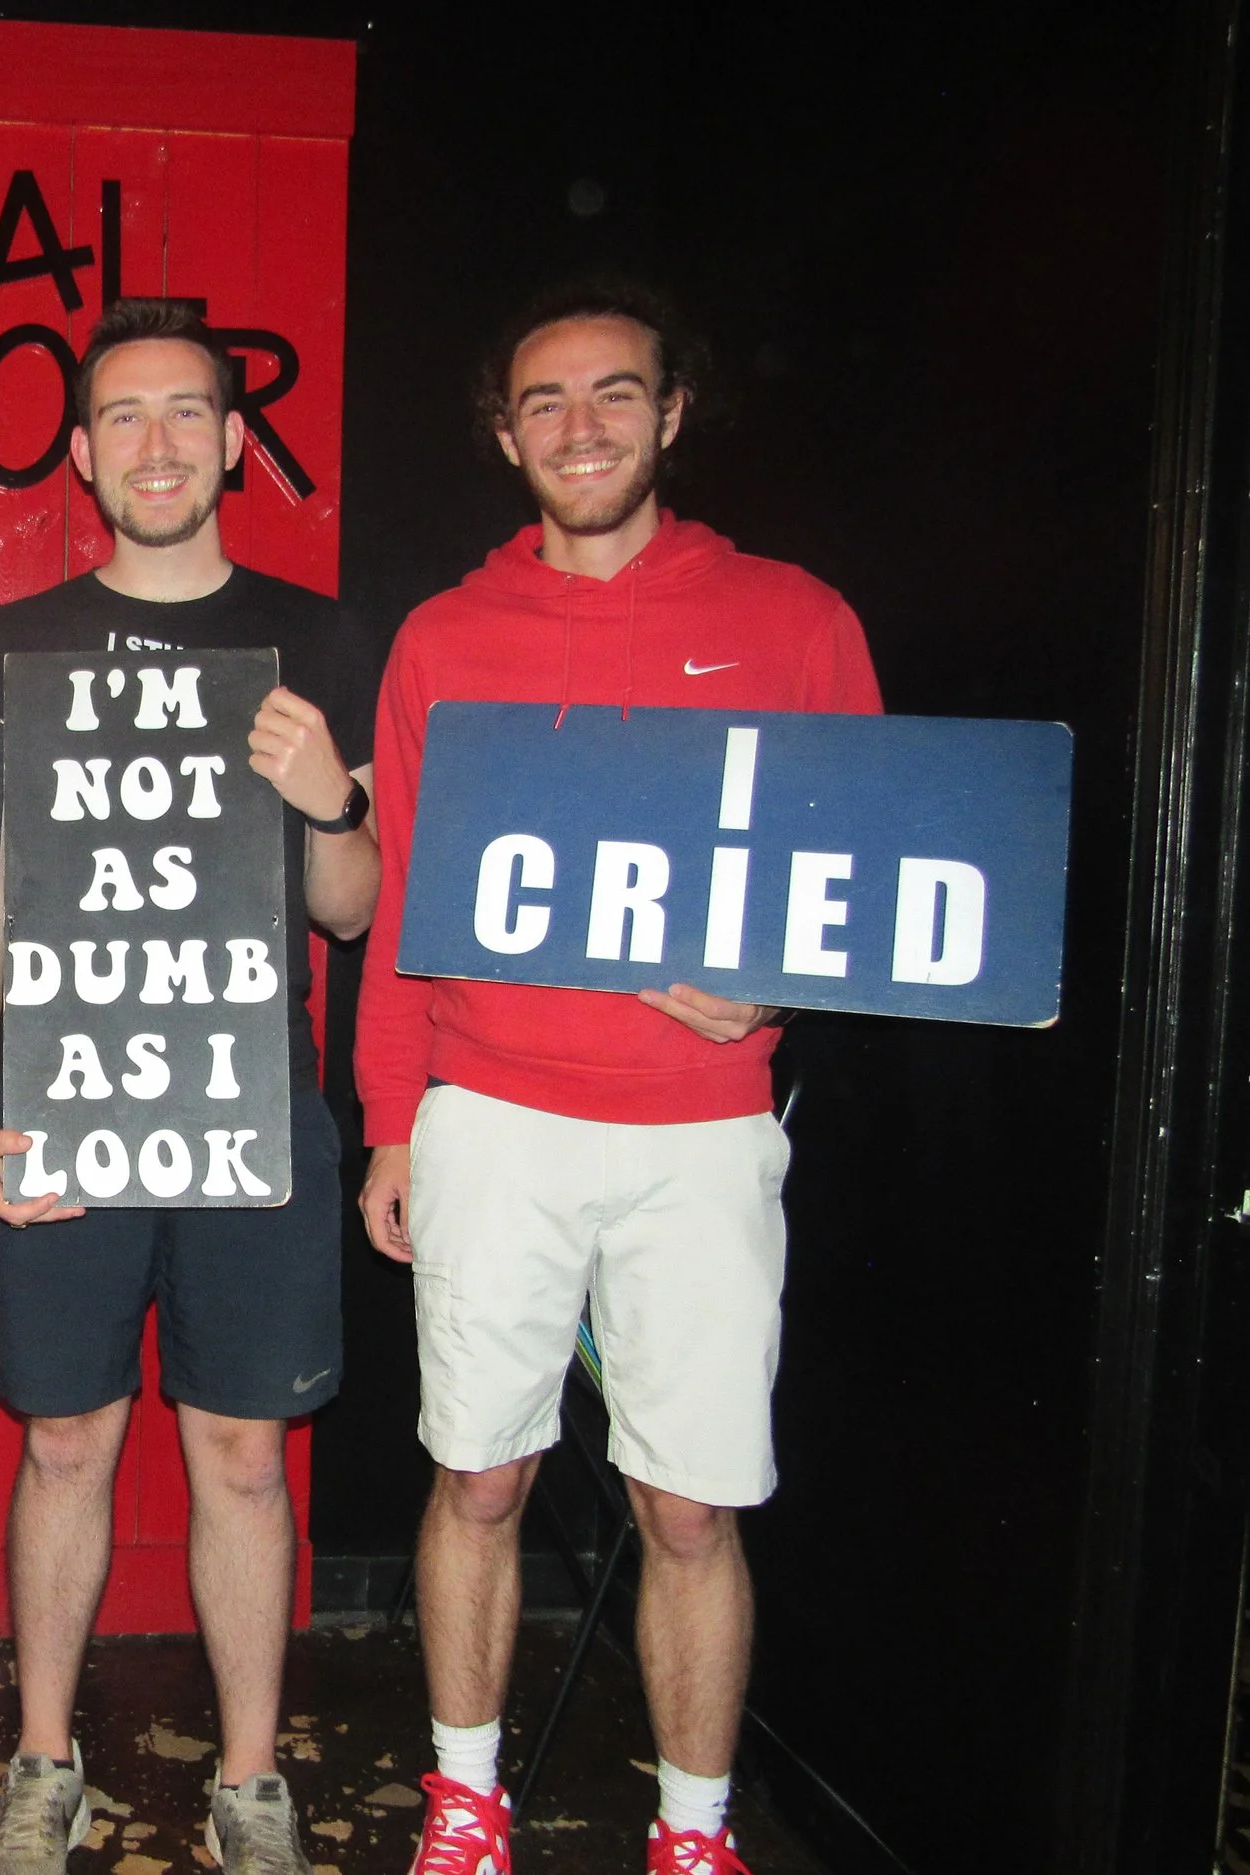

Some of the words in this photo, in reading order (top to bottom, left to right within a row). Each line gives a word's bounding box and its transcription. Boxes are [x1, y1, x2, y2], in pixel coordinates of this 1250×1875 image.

[65, 667, 208, 732] I'M
[50, 755, 226, 822] NOT
[717, 727, 760, 831] I
[78, 846, 198, 913] AS
[472, 833, 987, 987] CRIED
[4, 938, 279, 1006] DUMB
[46, 1033, 172, 1101] AS
[205, 1033, 241, 1100] I
[19, 1128, 272, 1200] LOOK
